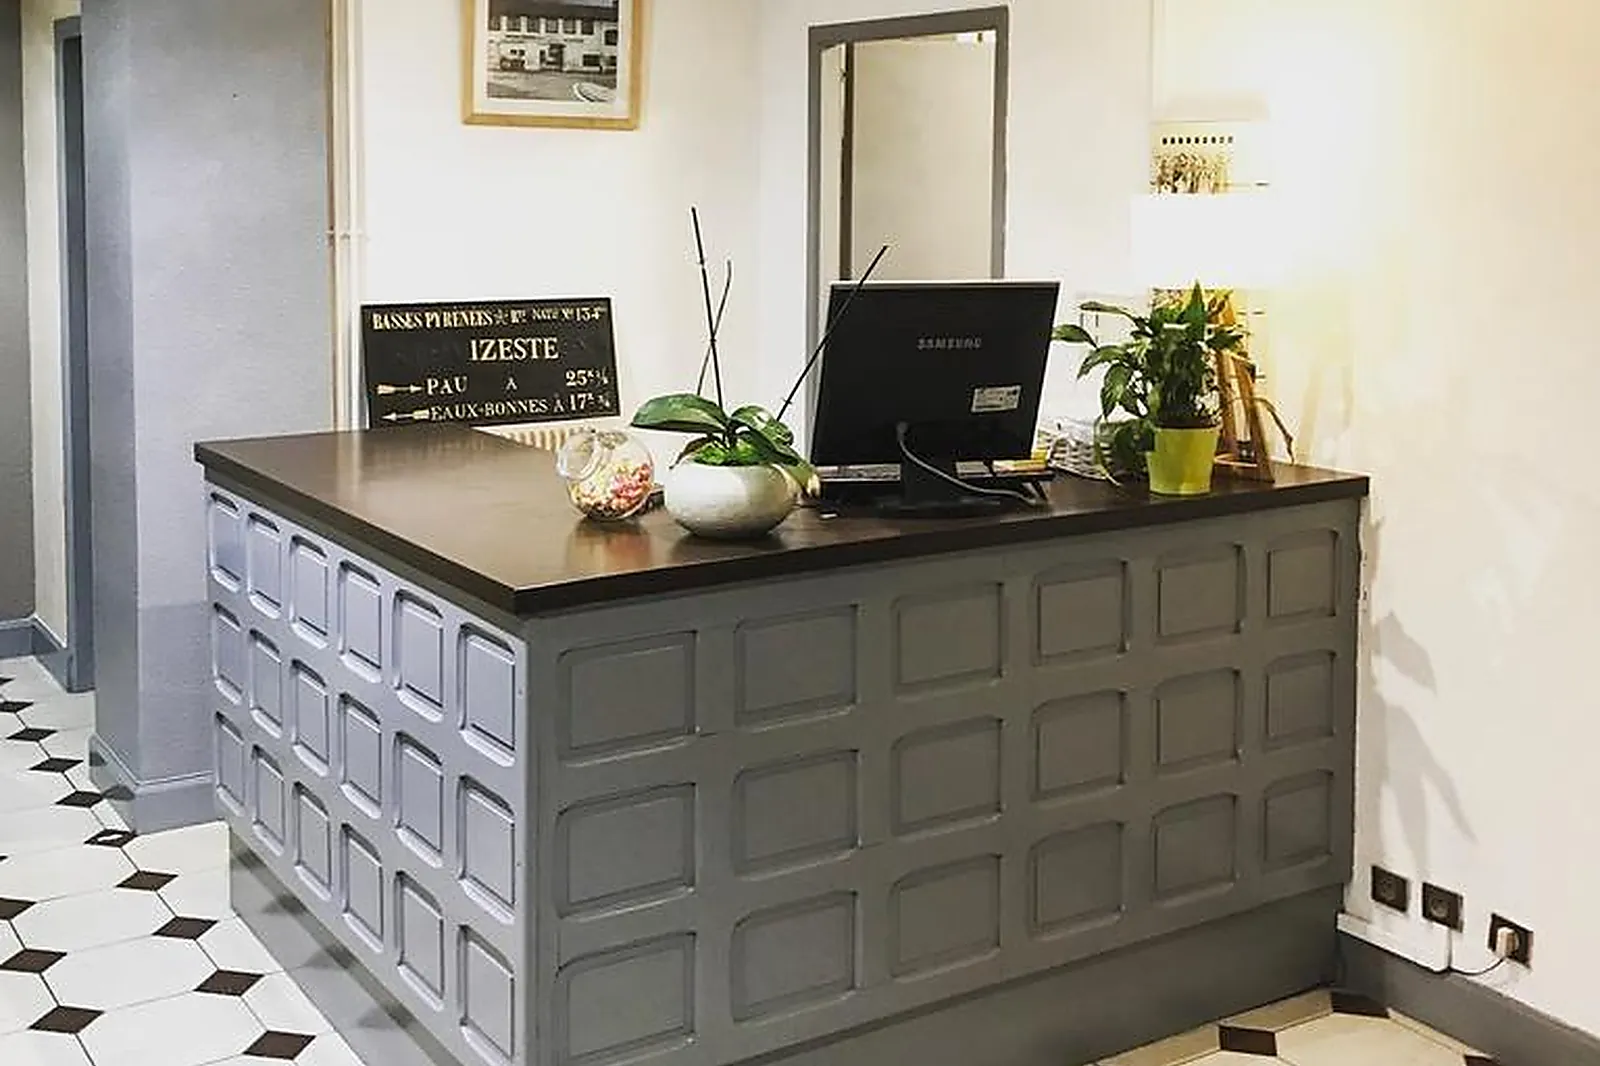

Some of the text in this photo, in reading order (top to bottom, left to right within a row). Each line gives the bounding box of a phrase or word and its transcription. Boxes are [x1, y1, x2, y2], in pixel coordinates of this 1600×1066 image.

[371, 311, 423, 331] BASSES
[469, 336, 560, 361] IZESTE
[426, 375, 468, 396] PAU
